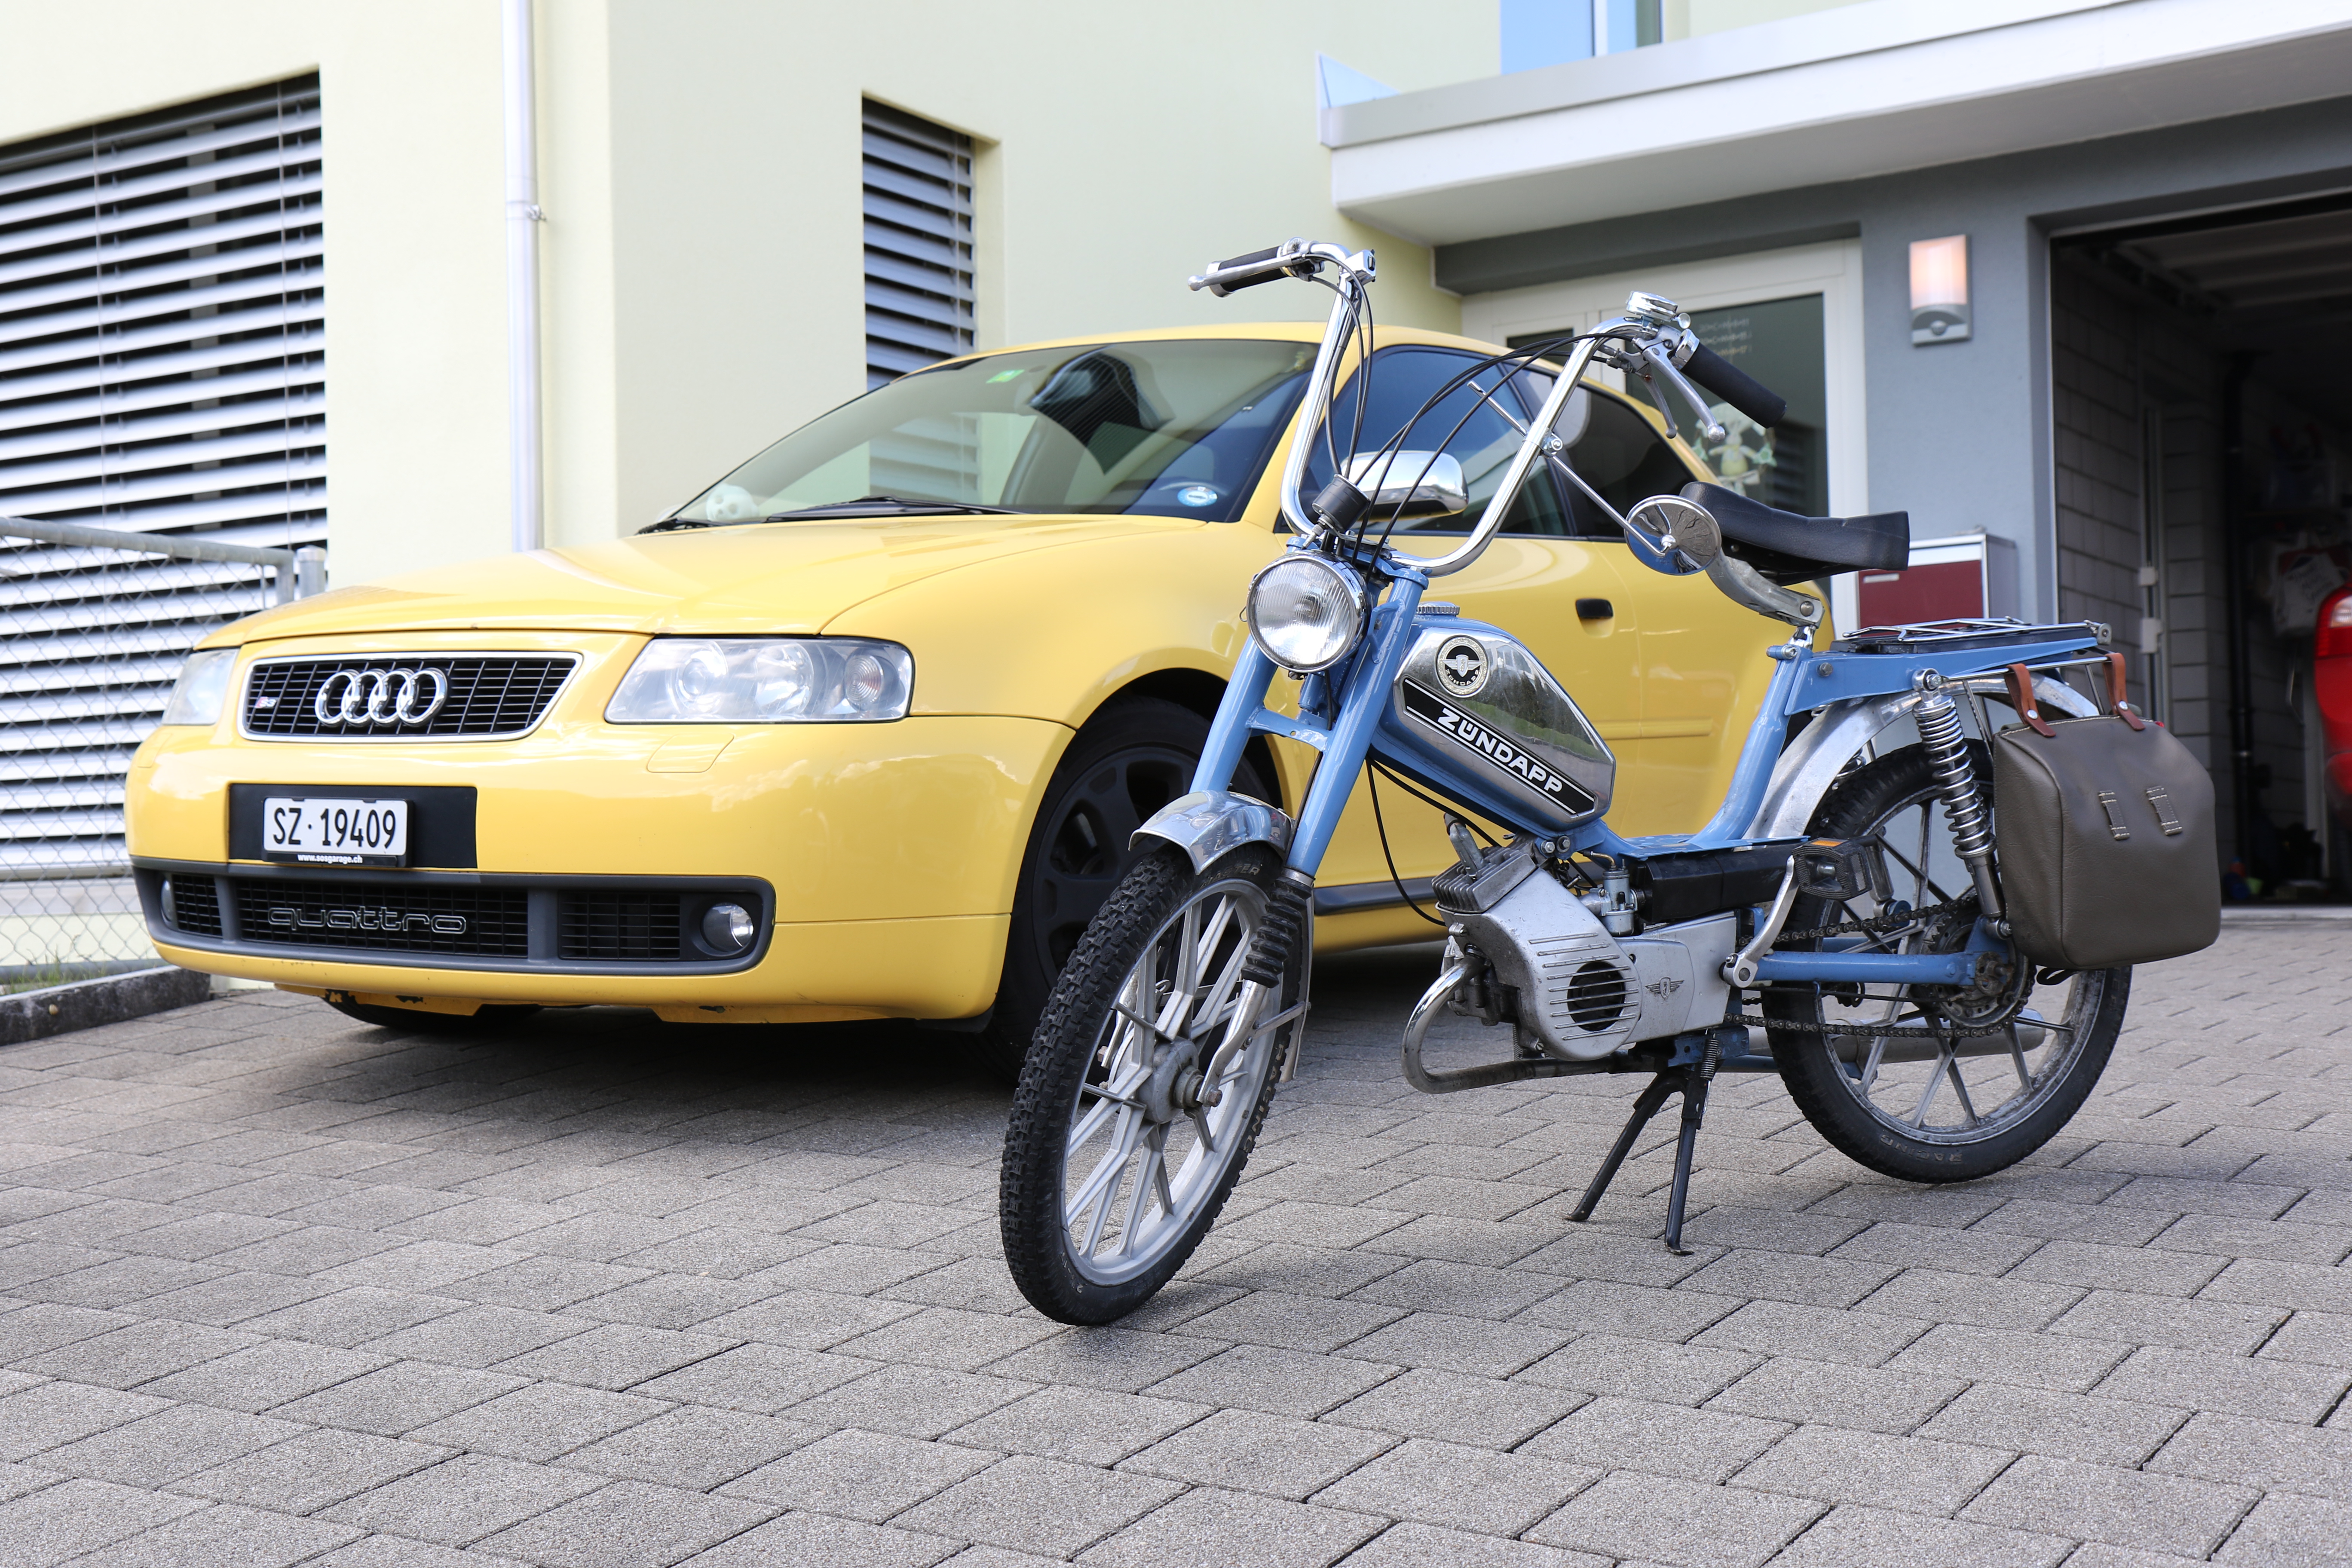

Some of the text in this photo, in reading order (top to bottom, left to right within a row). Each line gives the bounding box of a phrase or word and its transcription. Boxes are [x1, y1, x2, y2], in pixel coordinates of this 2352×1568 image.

[1437, 707, 1563, 793] ZÜNDAPP
[297, 854, 363, 864] www.sosgarage.ch
[268, 906, 467, 934] quattro
[1879, 1134, 1963, 1163] RACING
